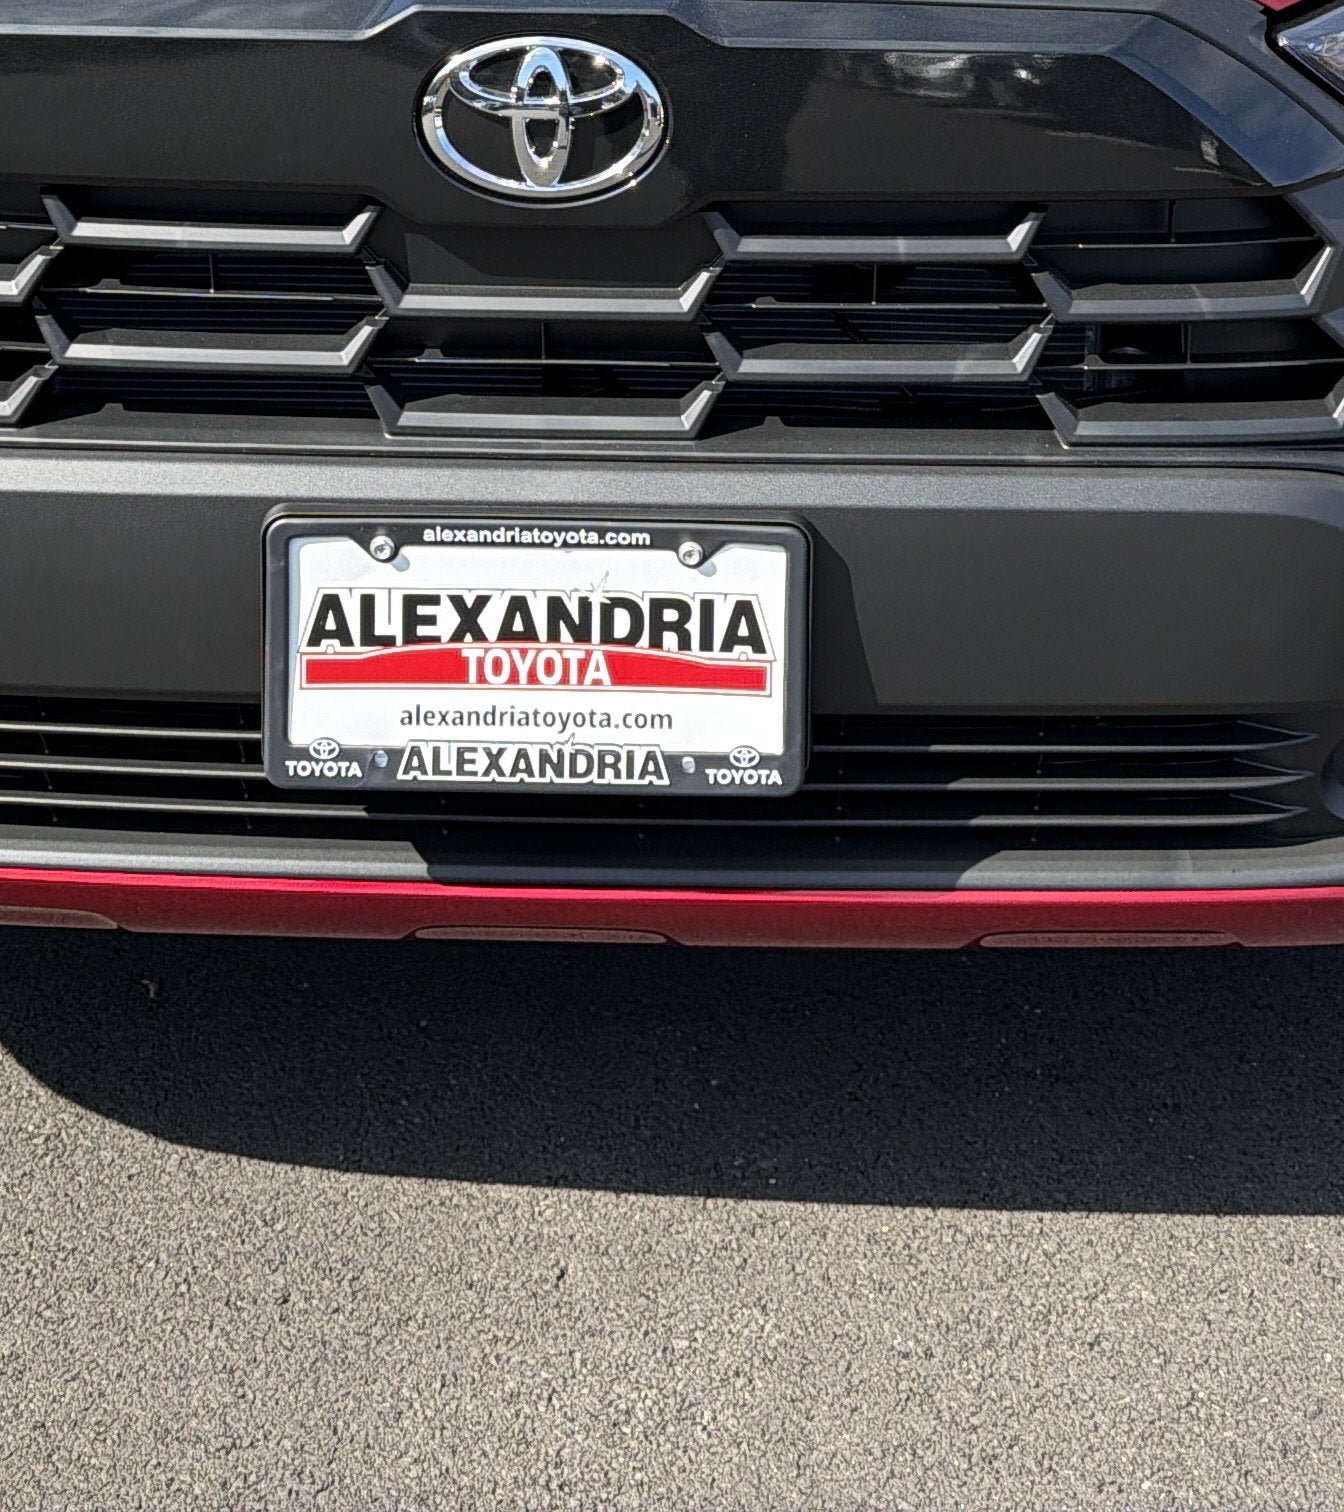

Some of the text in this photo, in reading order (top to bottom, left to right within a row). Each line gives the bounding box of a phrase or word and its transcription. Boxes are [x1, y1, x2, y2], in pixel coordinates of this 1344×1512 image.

[423, 526, 651, 548] alexandriatoyota.com
[306, 592, 768, 655] ALEXANDRIA
[461, 648, 612, 686] TOYOTA
[399, 703, 673, 734] alexandriatoyota.com
[285, 760, 363, 778] TOYOTA
[400, 745, 665, 781] ALEXANDRIA
[704, 768, 783, 786] TOYOTA
